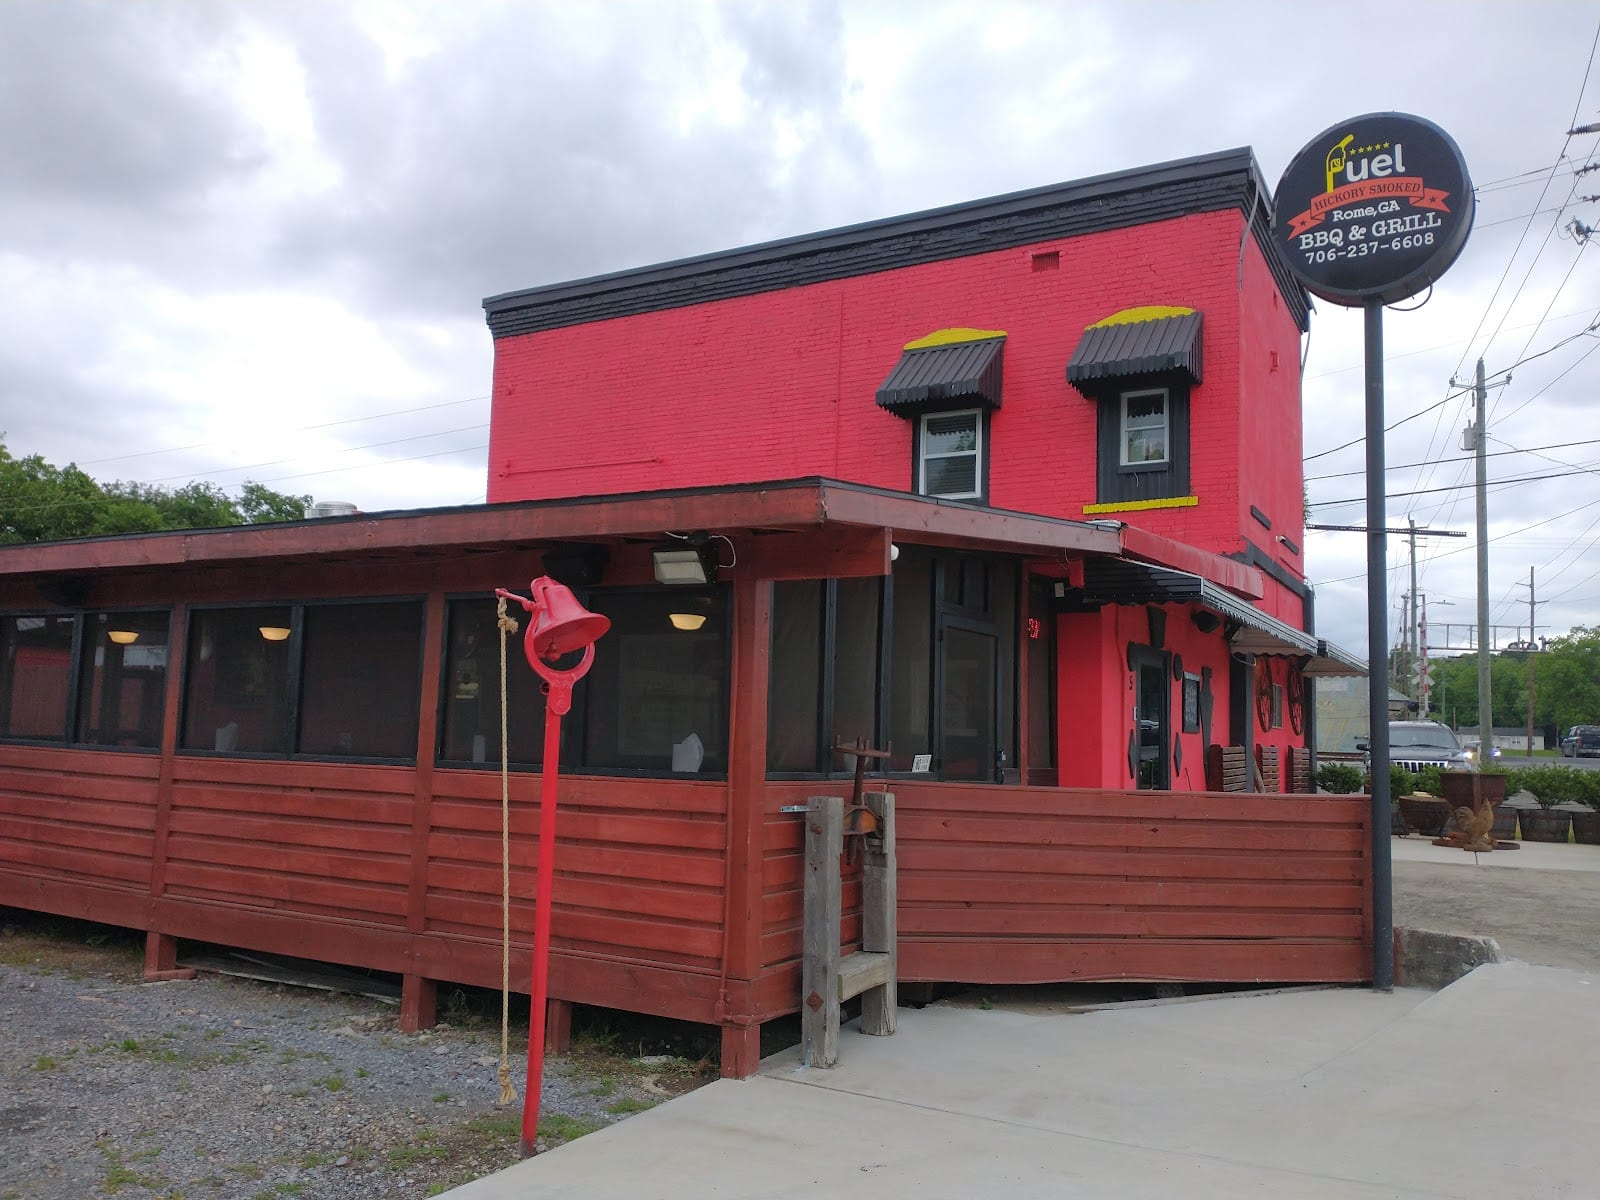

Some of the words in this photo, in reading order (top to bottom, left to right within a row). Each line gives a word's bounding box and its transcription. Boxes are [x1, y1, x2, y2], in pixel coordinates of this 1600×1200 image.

[1313, 186, 1366, 211] HICKORY
[1368, 182, 1421, 195] SMOKED
[1299, 228, 1344, 250] BBQ
[1348, 224, 1367, 241] &
[1371, 211, 1442, 238] GRILL
[1305, 232, 1435, 264] 706-237-6608
